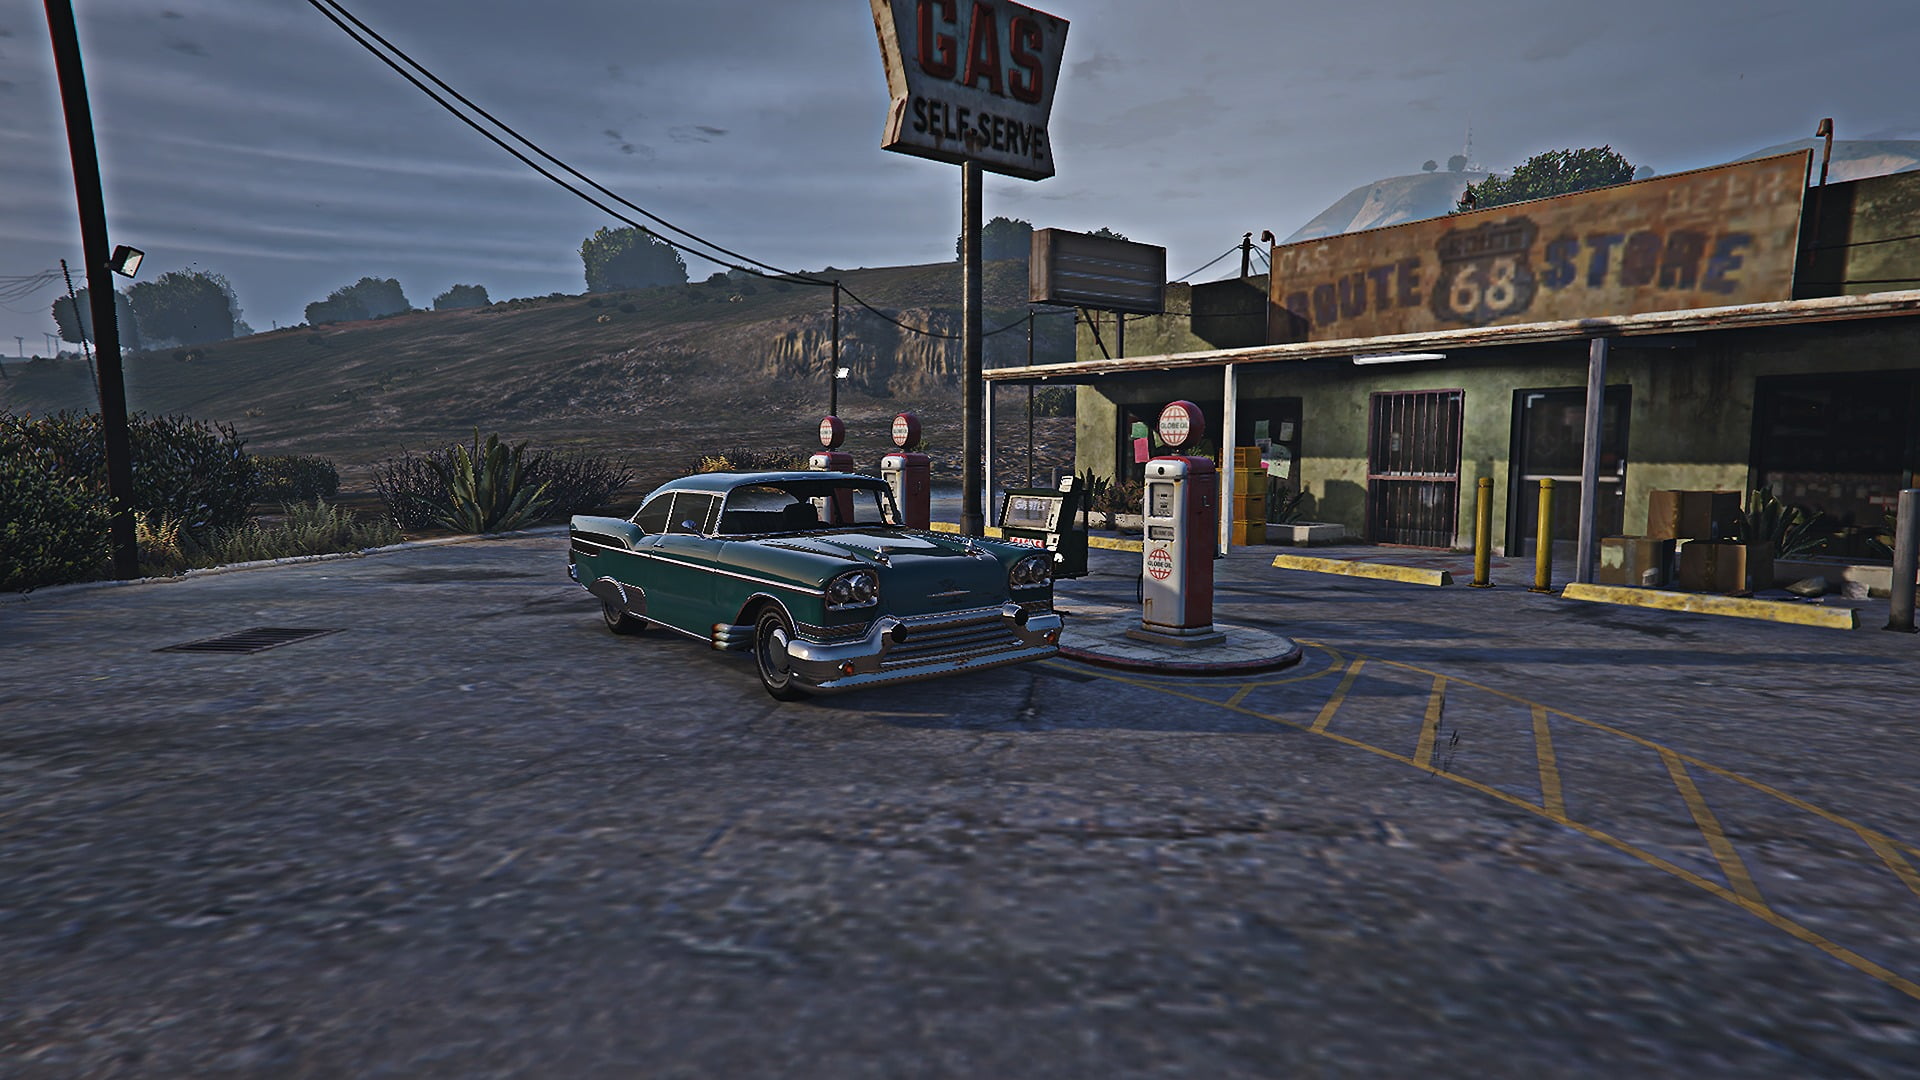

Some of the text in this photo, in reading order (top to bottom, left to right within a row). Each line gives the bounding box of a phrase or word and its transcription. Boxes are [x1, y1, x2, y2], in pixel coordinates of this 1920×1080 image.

[917, 0, 1044, 105] GAS
[912, 97, 1045, 160] SELF-SERVE
[1286, 256, 1423, 337] ROUTE
[1449, 257, 1516, 314] 68
[1541, 227, 1753, 295] STORE
